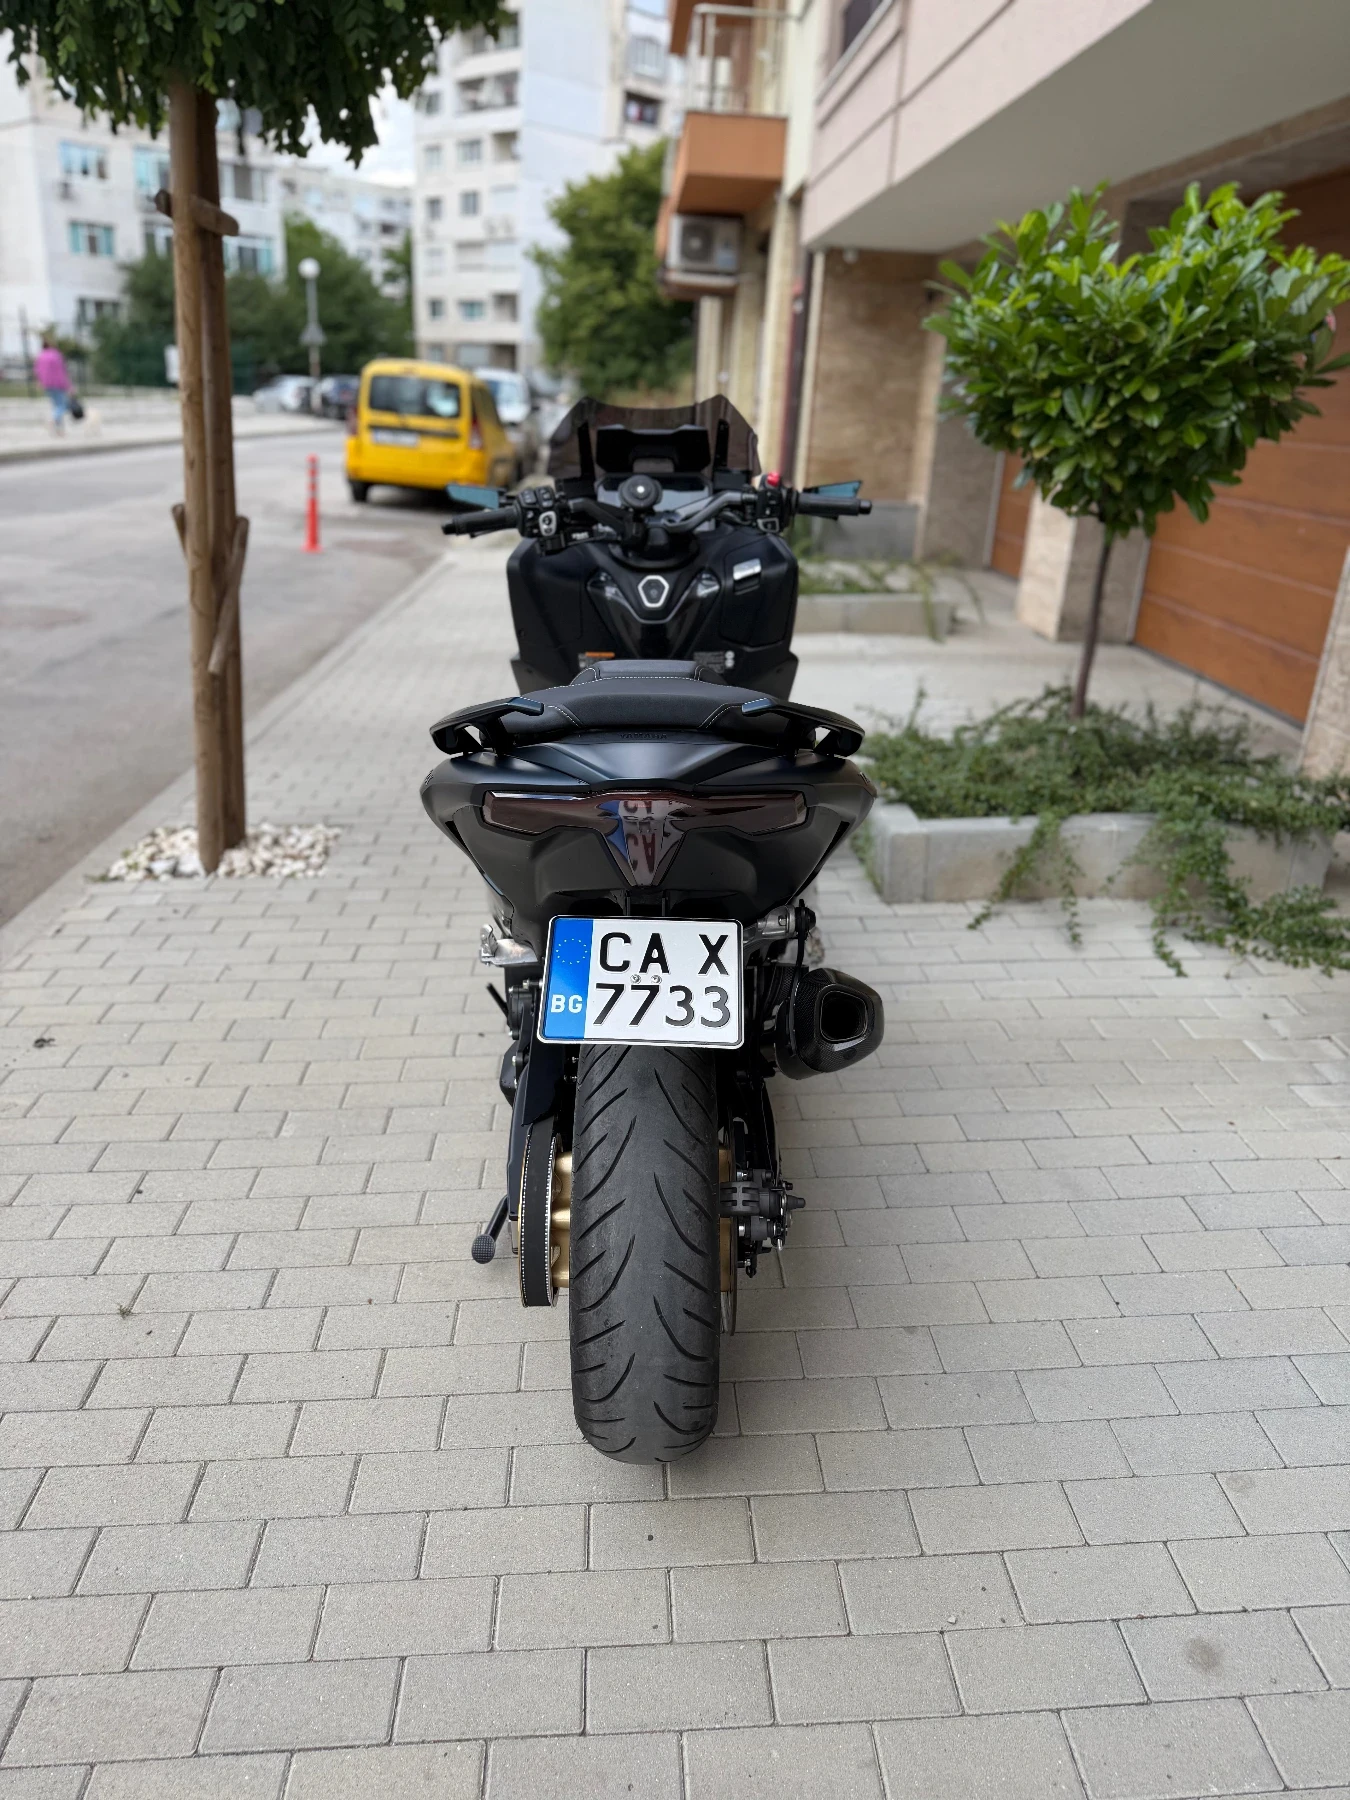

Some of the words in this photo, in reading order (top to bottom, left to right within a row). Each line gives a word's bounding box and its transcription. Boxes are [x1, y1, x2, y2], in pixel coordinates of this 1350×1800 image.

[599, 932, 670, 974] CA
[698, 934, 729, 975] X
[551, 994, 583, 1013] BG
[593, 983, 731, 1028] 7733
